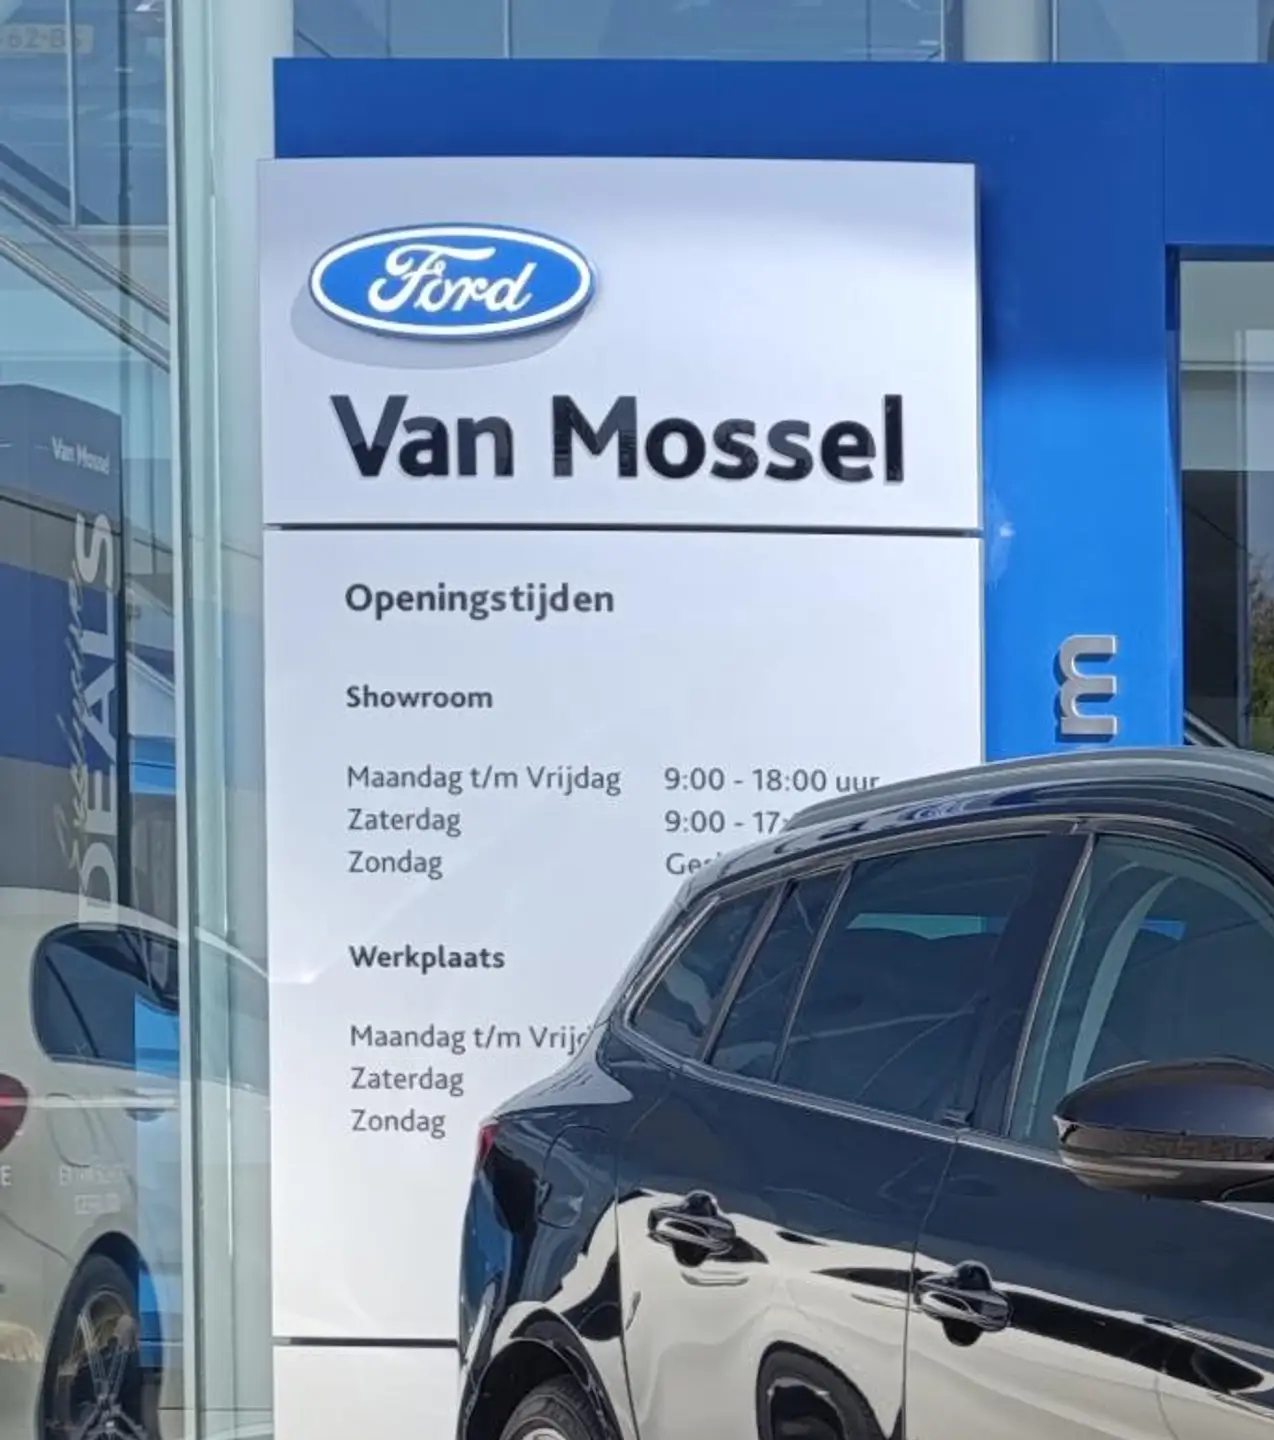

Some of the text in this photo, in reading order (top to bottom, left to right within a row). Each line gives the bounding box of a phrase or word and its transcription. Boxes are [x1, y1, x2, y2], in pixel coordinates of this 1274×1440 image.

[366, 242, 537, 314] Ford
[330, 394, 905, 484] Van Mossel
[344, 582, 615, 621] Openingstijden
[345, 684, 494, 710] Showroom
[75, 512, 120, 931] DEALS
[347, 764, 622, 797] Maandag t/m Vrijdag
[664, 767, 725, 791] 9:00
[752, 768, 827, 791] 18:00
[835, 775, 880, 792] uur
[347, 807, 462, 838] Zaterdag
[664, 810, 725, 833] 9:00
[348, 849, 444, 880] Zondag
[350, 945, 505, 975] Werkplaats
[351, 1024, 466, 1055] Maandag
[473, 1025, 520, 1049] t/m
[351, 1066, 464, 1097] Zaterdag
[352, 1108, 446, 1139] Zondag
